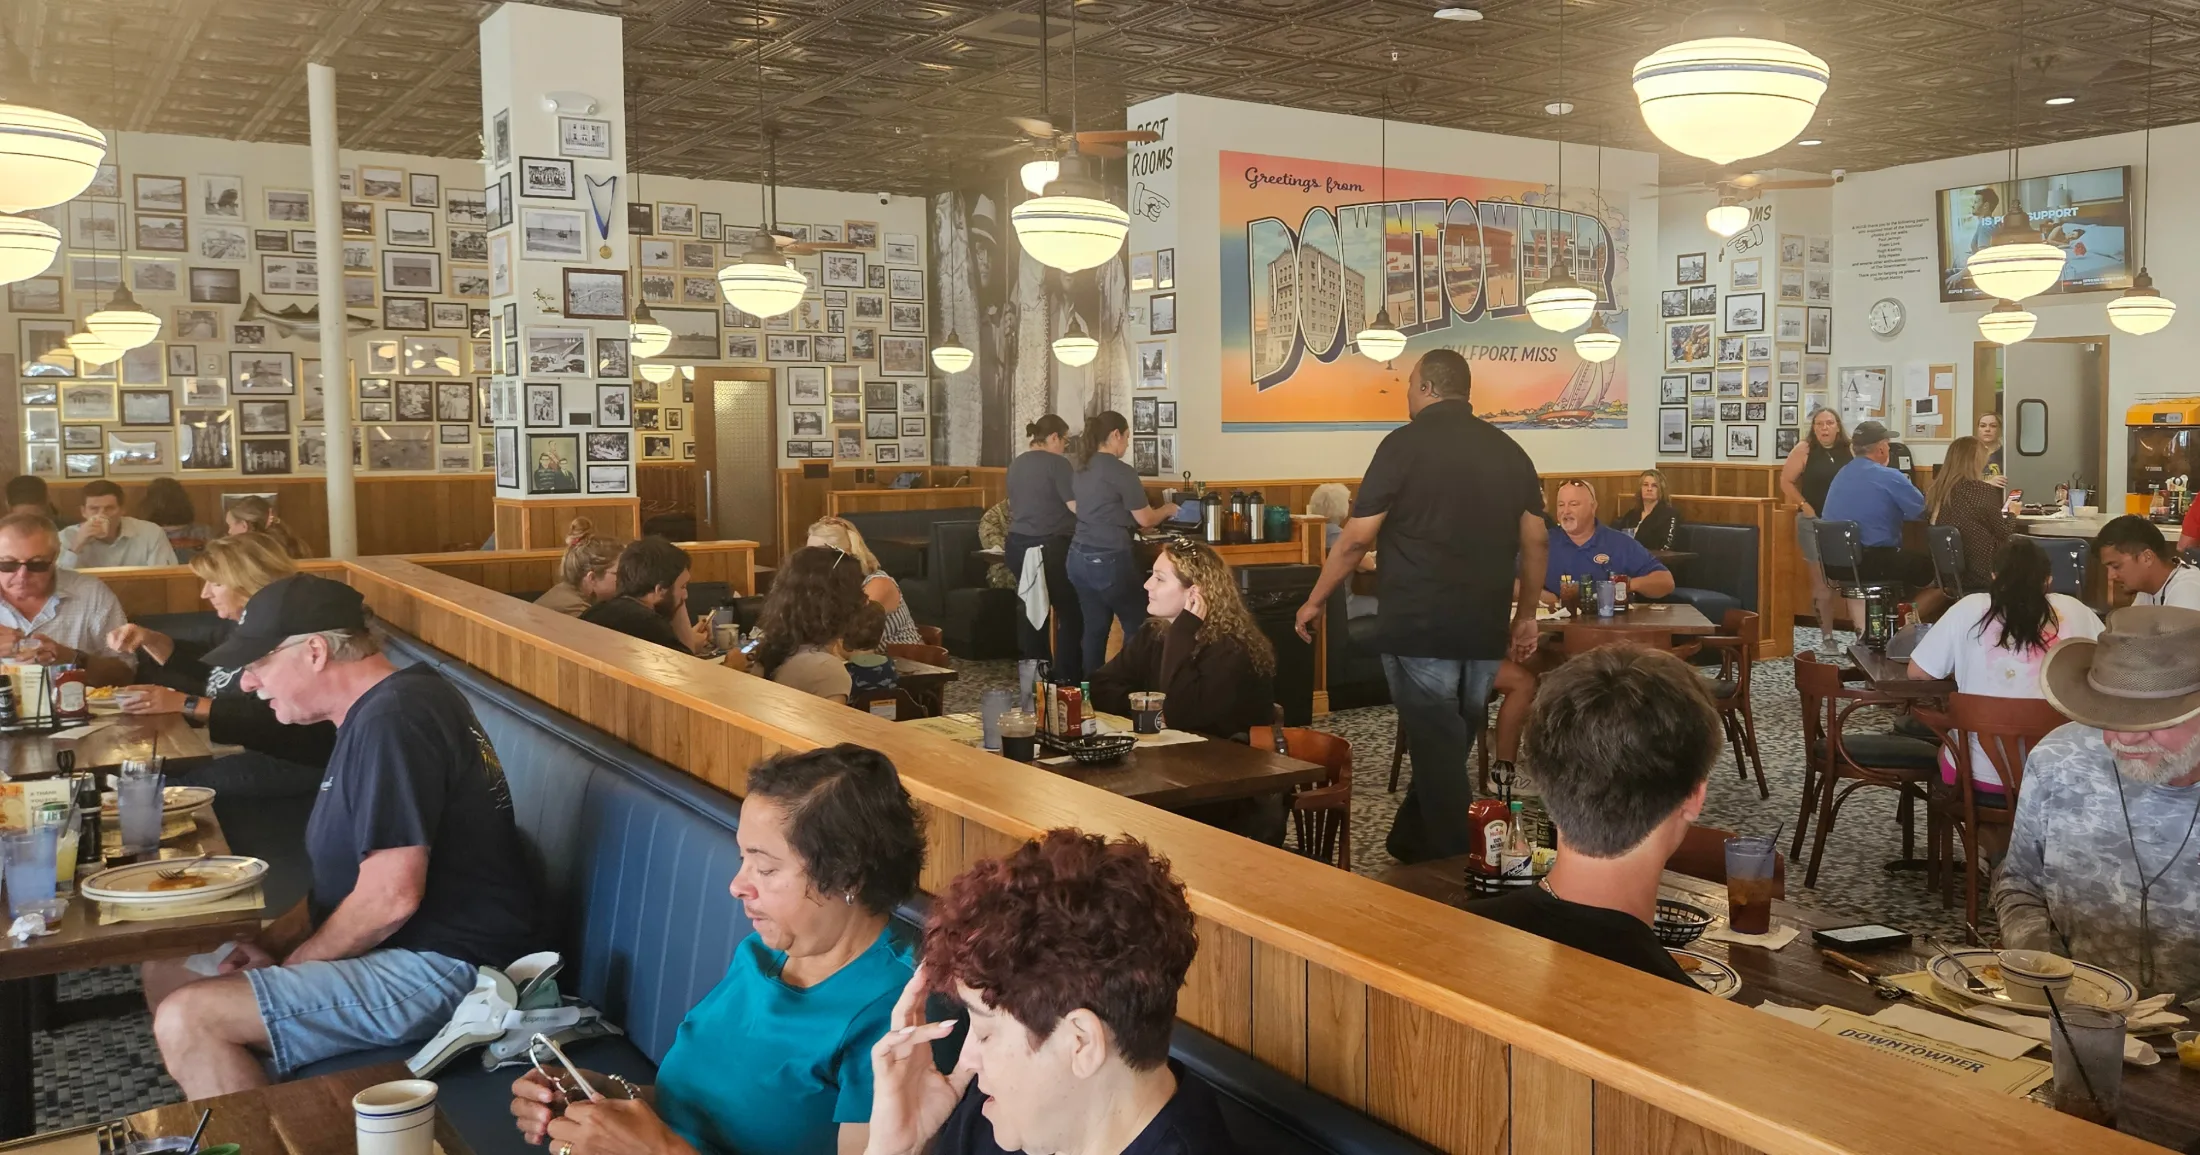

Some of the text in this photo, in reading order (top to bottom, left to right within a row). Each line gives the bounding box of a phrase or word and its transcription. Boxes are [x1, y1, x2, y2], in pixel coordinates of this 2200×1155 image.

[1132, 146, 1174, 177] ROOMS
[1244, 166, 1365, 194] Greetings from
[2029, 207, 2079, 222] SUPPORT
[1247, 197, 1618, 391] DOWNTOWNER
[1442, 344, 1558, 363] LFPORT, MISS
[1838, 1028, 1985, 1073] DOWNTOWNER
